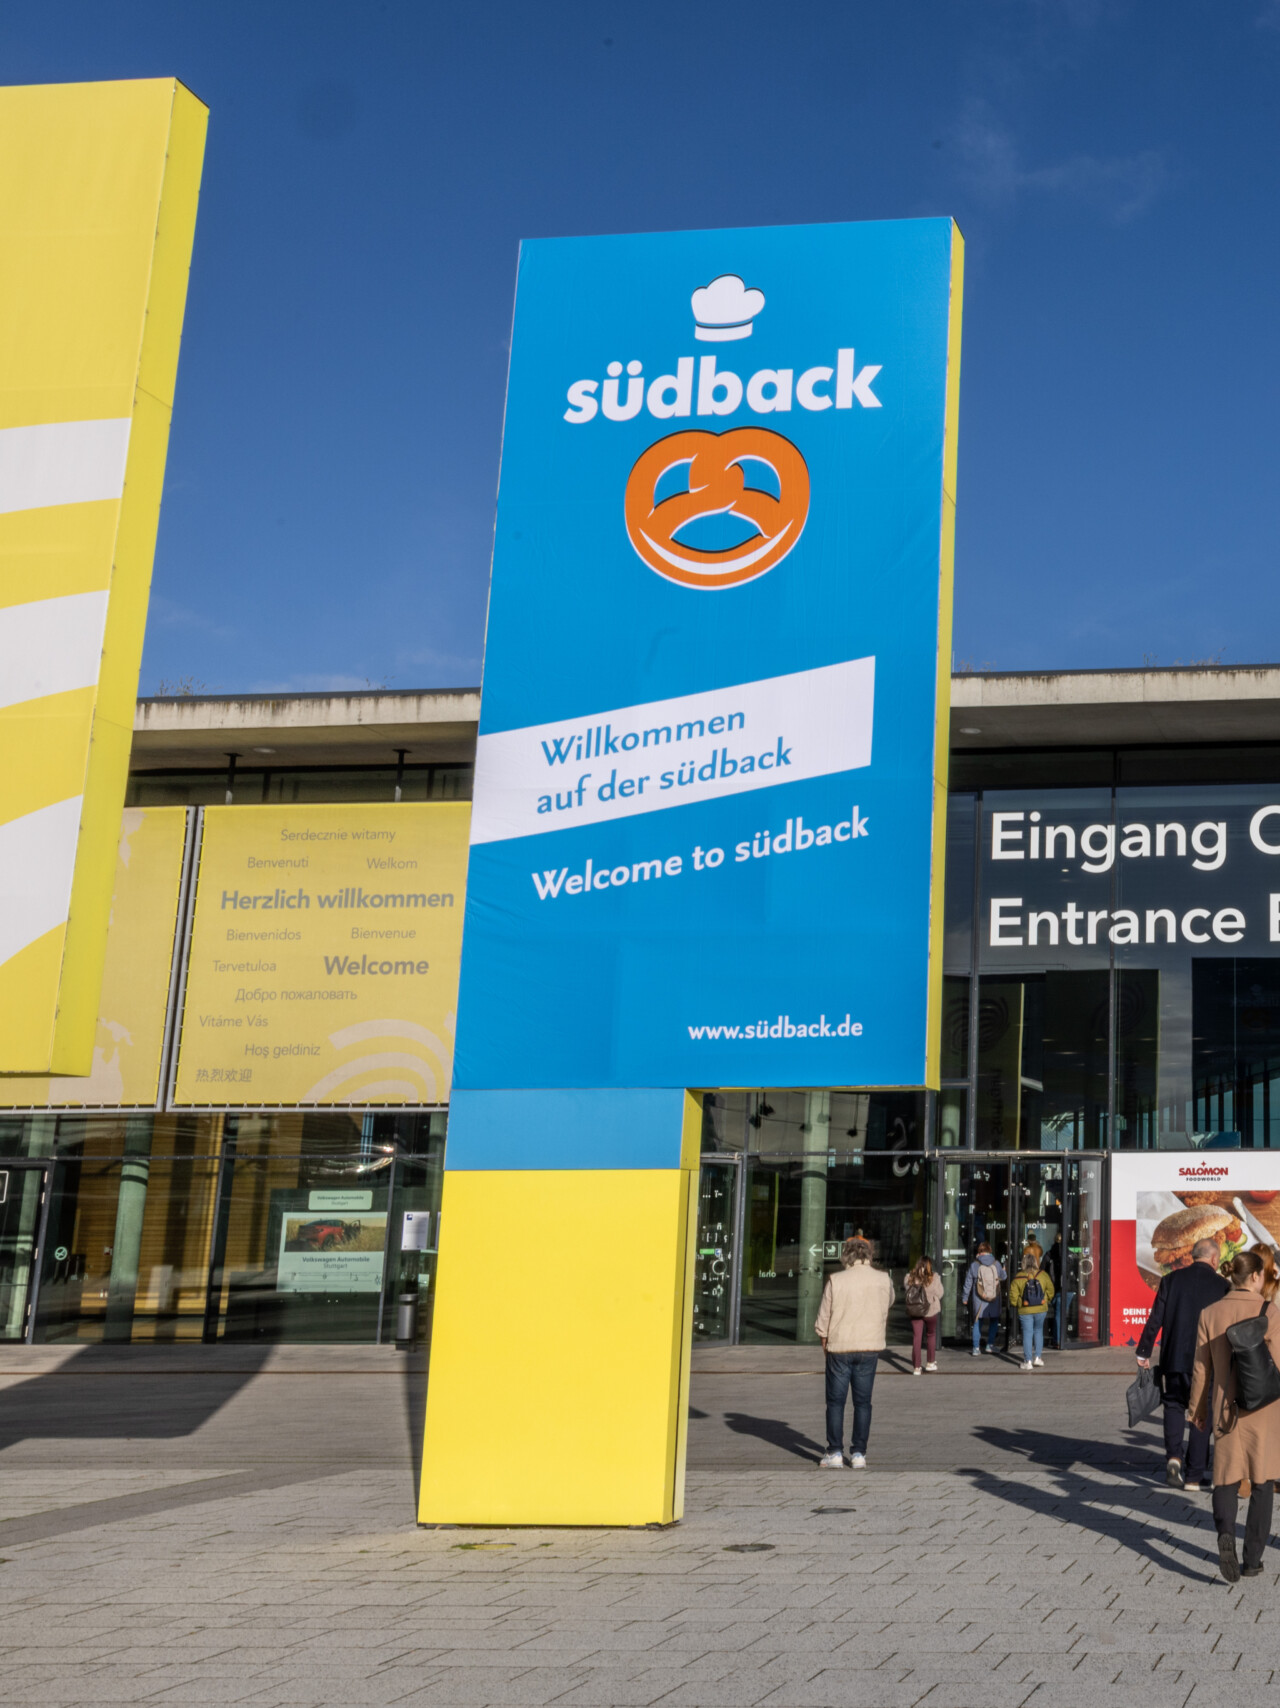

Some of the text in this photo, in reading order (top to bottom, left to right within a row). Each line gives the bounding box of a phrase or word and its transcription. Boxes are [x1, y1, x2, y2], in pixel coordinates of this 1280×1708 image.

[562, 346, 884, 425] südback
[541, 710, 746, 766] Willkommen
[536, 736, 793, 815] auf der südback
[281, 829, 397, 844] Serdecznie witamy
[990, 810, 1229, 875] Eingang
[531, 805, 870, 901] Welcome to südback
[247, 857, 310, 869] Benvenuti
[366, 858, 418, 870] Welkom
[220, 887, 455, 911] Herzlich willkommen
[988, 896, 1248, 949] Entrance
[226, 929, 302, 942] Bienvenidos
[351, 927, 417, 940] Bienvenue
[212, 960, 277, 973] Tervetuloa
[323, 955, 430, 976] Welcome
[234, 988, 358, 1003] Добро пожаловать
[246, 1014, 269, 1027] Vás
[688, 1013, 864, 1041] www.südback.de
[244, 1044, 321, 1058] Hoş geldiniz
[195, 1068, 253, 1083] 热烈欢迎
[1178, 1167, 1229, 1176] SALOMON
[302, 1256, 336, 1264] Volkswagen
[1122, 1308, 1147, 1316] DEINE
